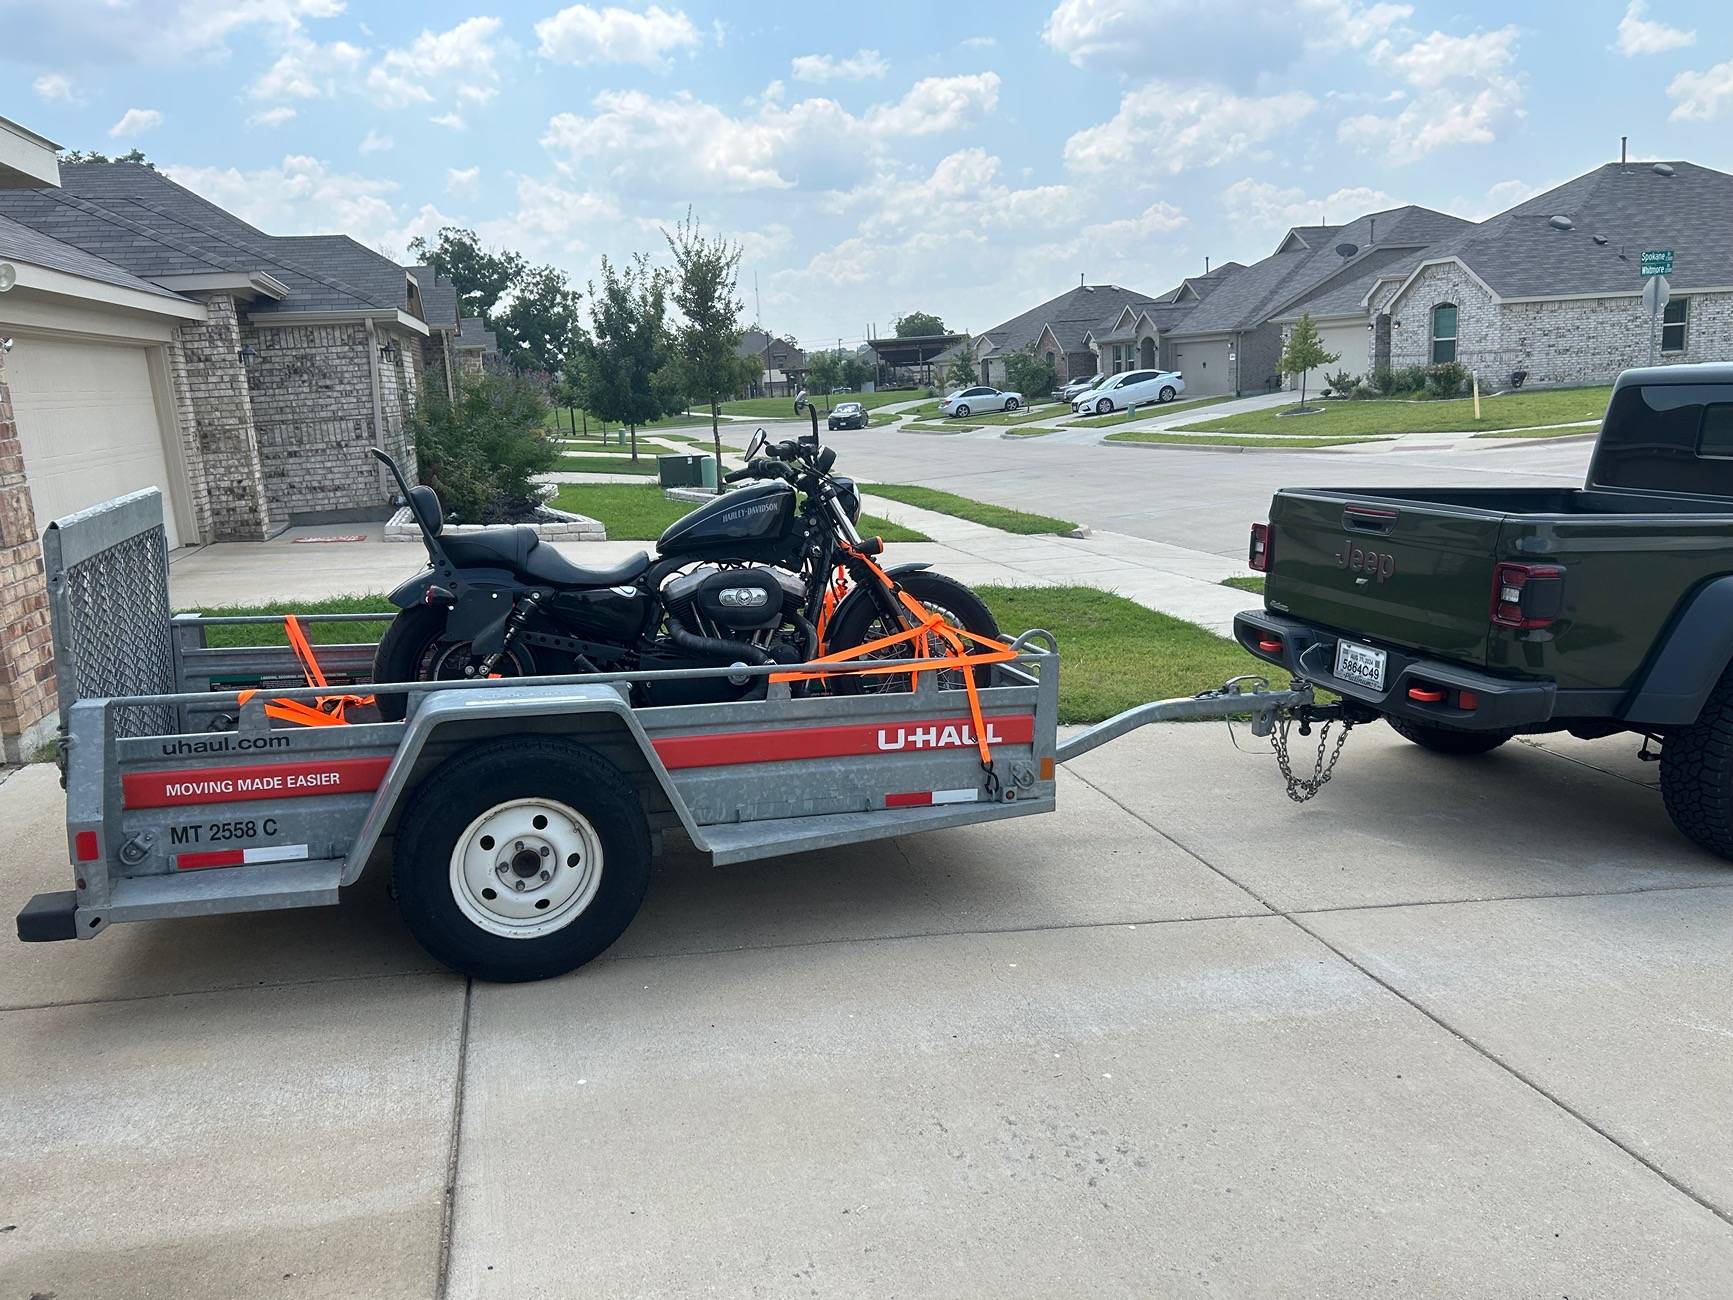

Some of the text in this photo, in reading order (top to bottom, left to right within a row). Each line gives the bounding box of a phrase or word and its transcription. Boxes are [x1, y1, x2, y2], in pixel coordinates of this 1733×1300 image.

[1641, 252, 1666, 262] Spokane
[1641, 266, 1665, 276] Whitmore
[722, 502, 778, 523] HARLEY-DAVIDSON
[1335, 540, 1395, 585] Jeep
[1342, 659, 1380, 680] 5864C49
[162, 736, 290, 755] uhaul.com
[166, 773, 341, 797] MOVING MADE EASIER
[170, 818, 278, 845] MT 2558 C
